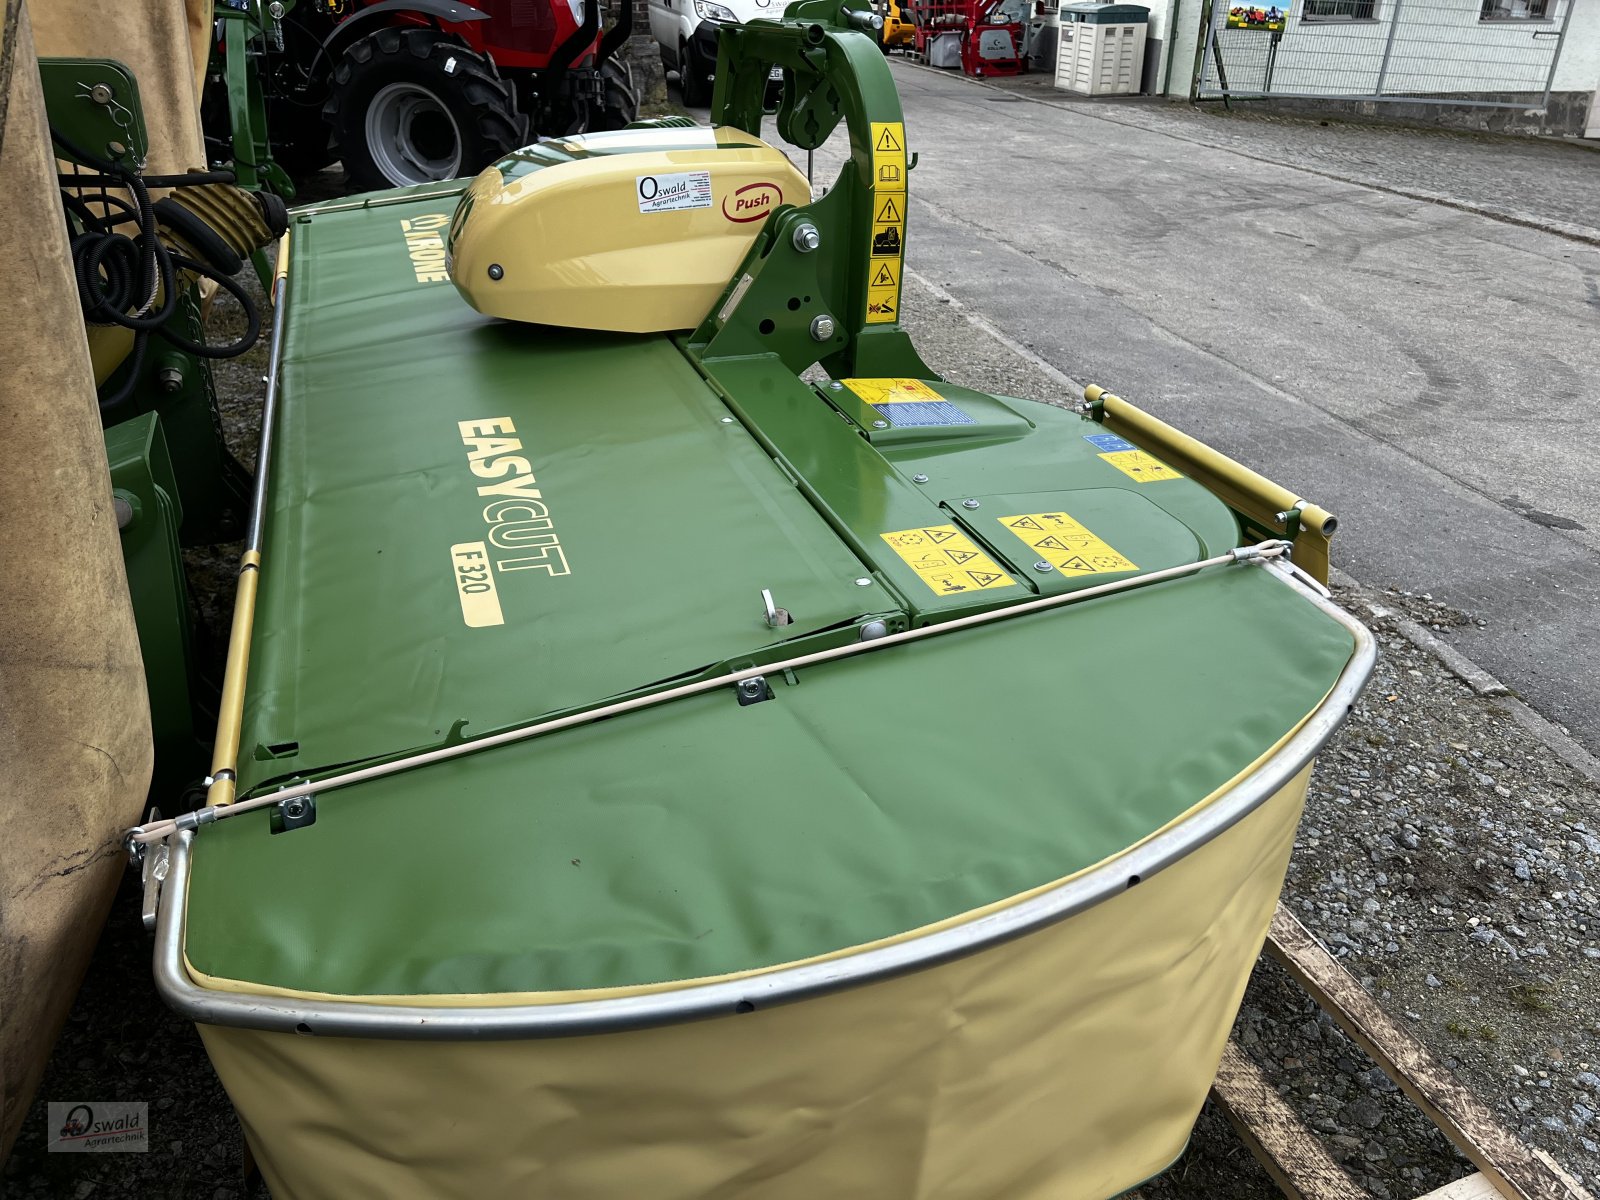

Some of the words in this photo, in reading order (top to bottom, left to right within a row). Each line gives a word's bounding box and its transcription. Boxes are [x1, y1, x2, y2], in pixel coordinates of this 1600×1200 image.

[640, 176, 686, 200] Oswald
[652, 192, 691, 207] Agrartechnik
[735, 193, 770, 211] Push
[404, 230, 451, 283] KRONE
[455, 550, 483, 560] F
[457, 563, 491, 594] 320
